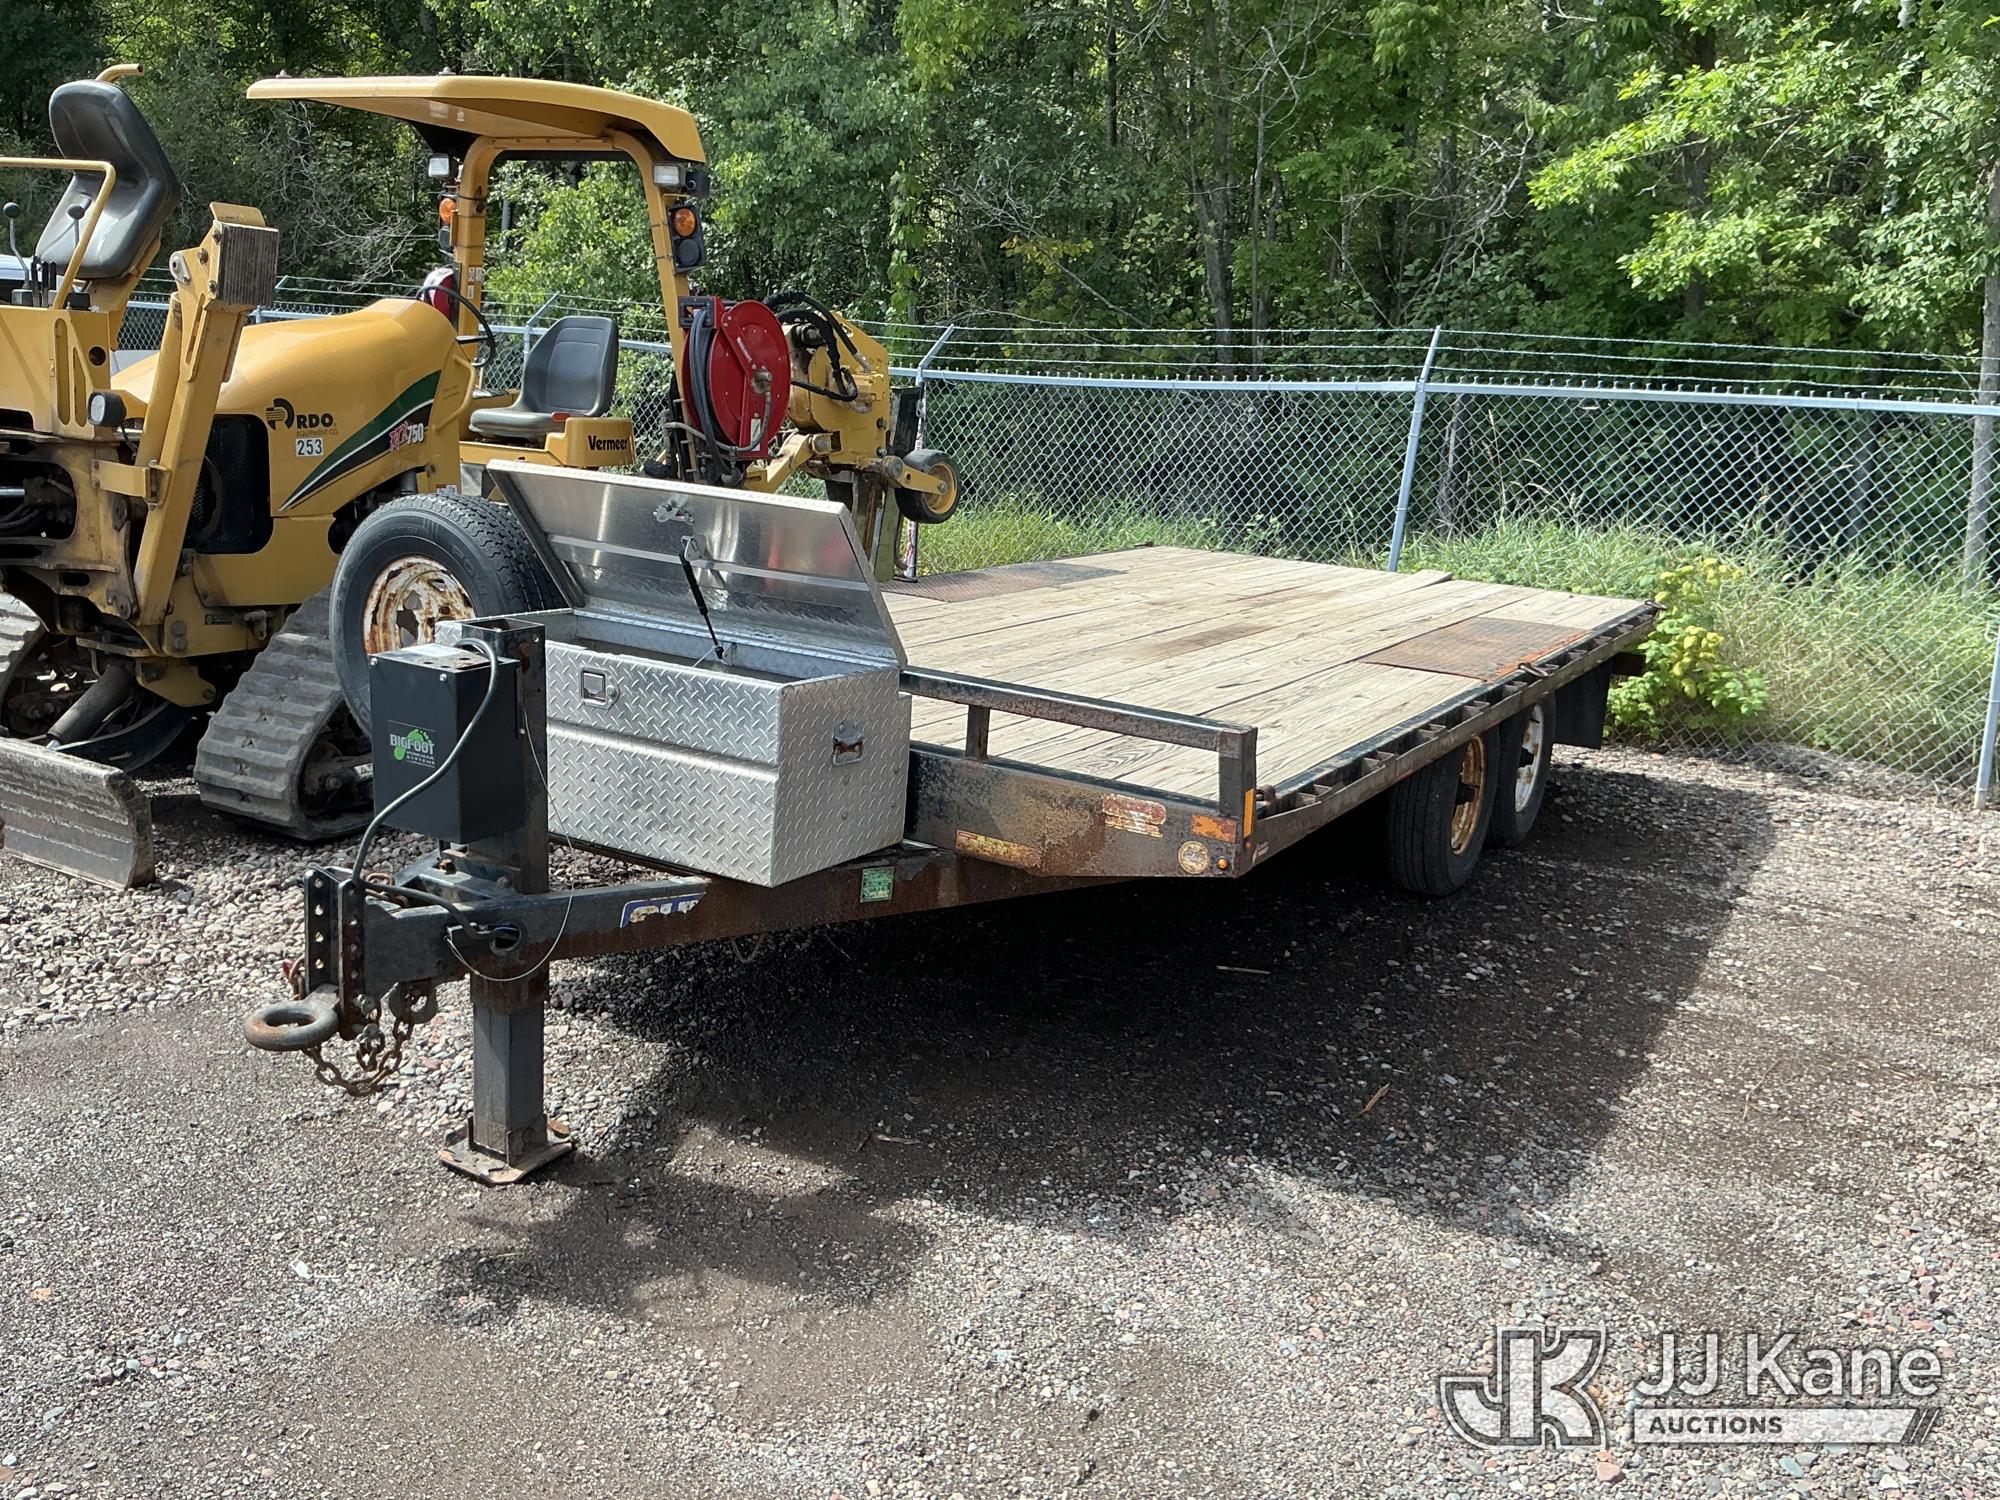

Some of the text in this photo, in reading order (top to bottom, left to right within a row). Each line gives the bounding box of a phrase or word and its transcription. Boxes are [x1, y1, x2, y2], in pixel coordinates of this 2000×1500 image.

[297, 439, 322, 455] 253
[587, 434, 628, 451] Vermeer
[390, 733, 435, 755] BIGFOOT
